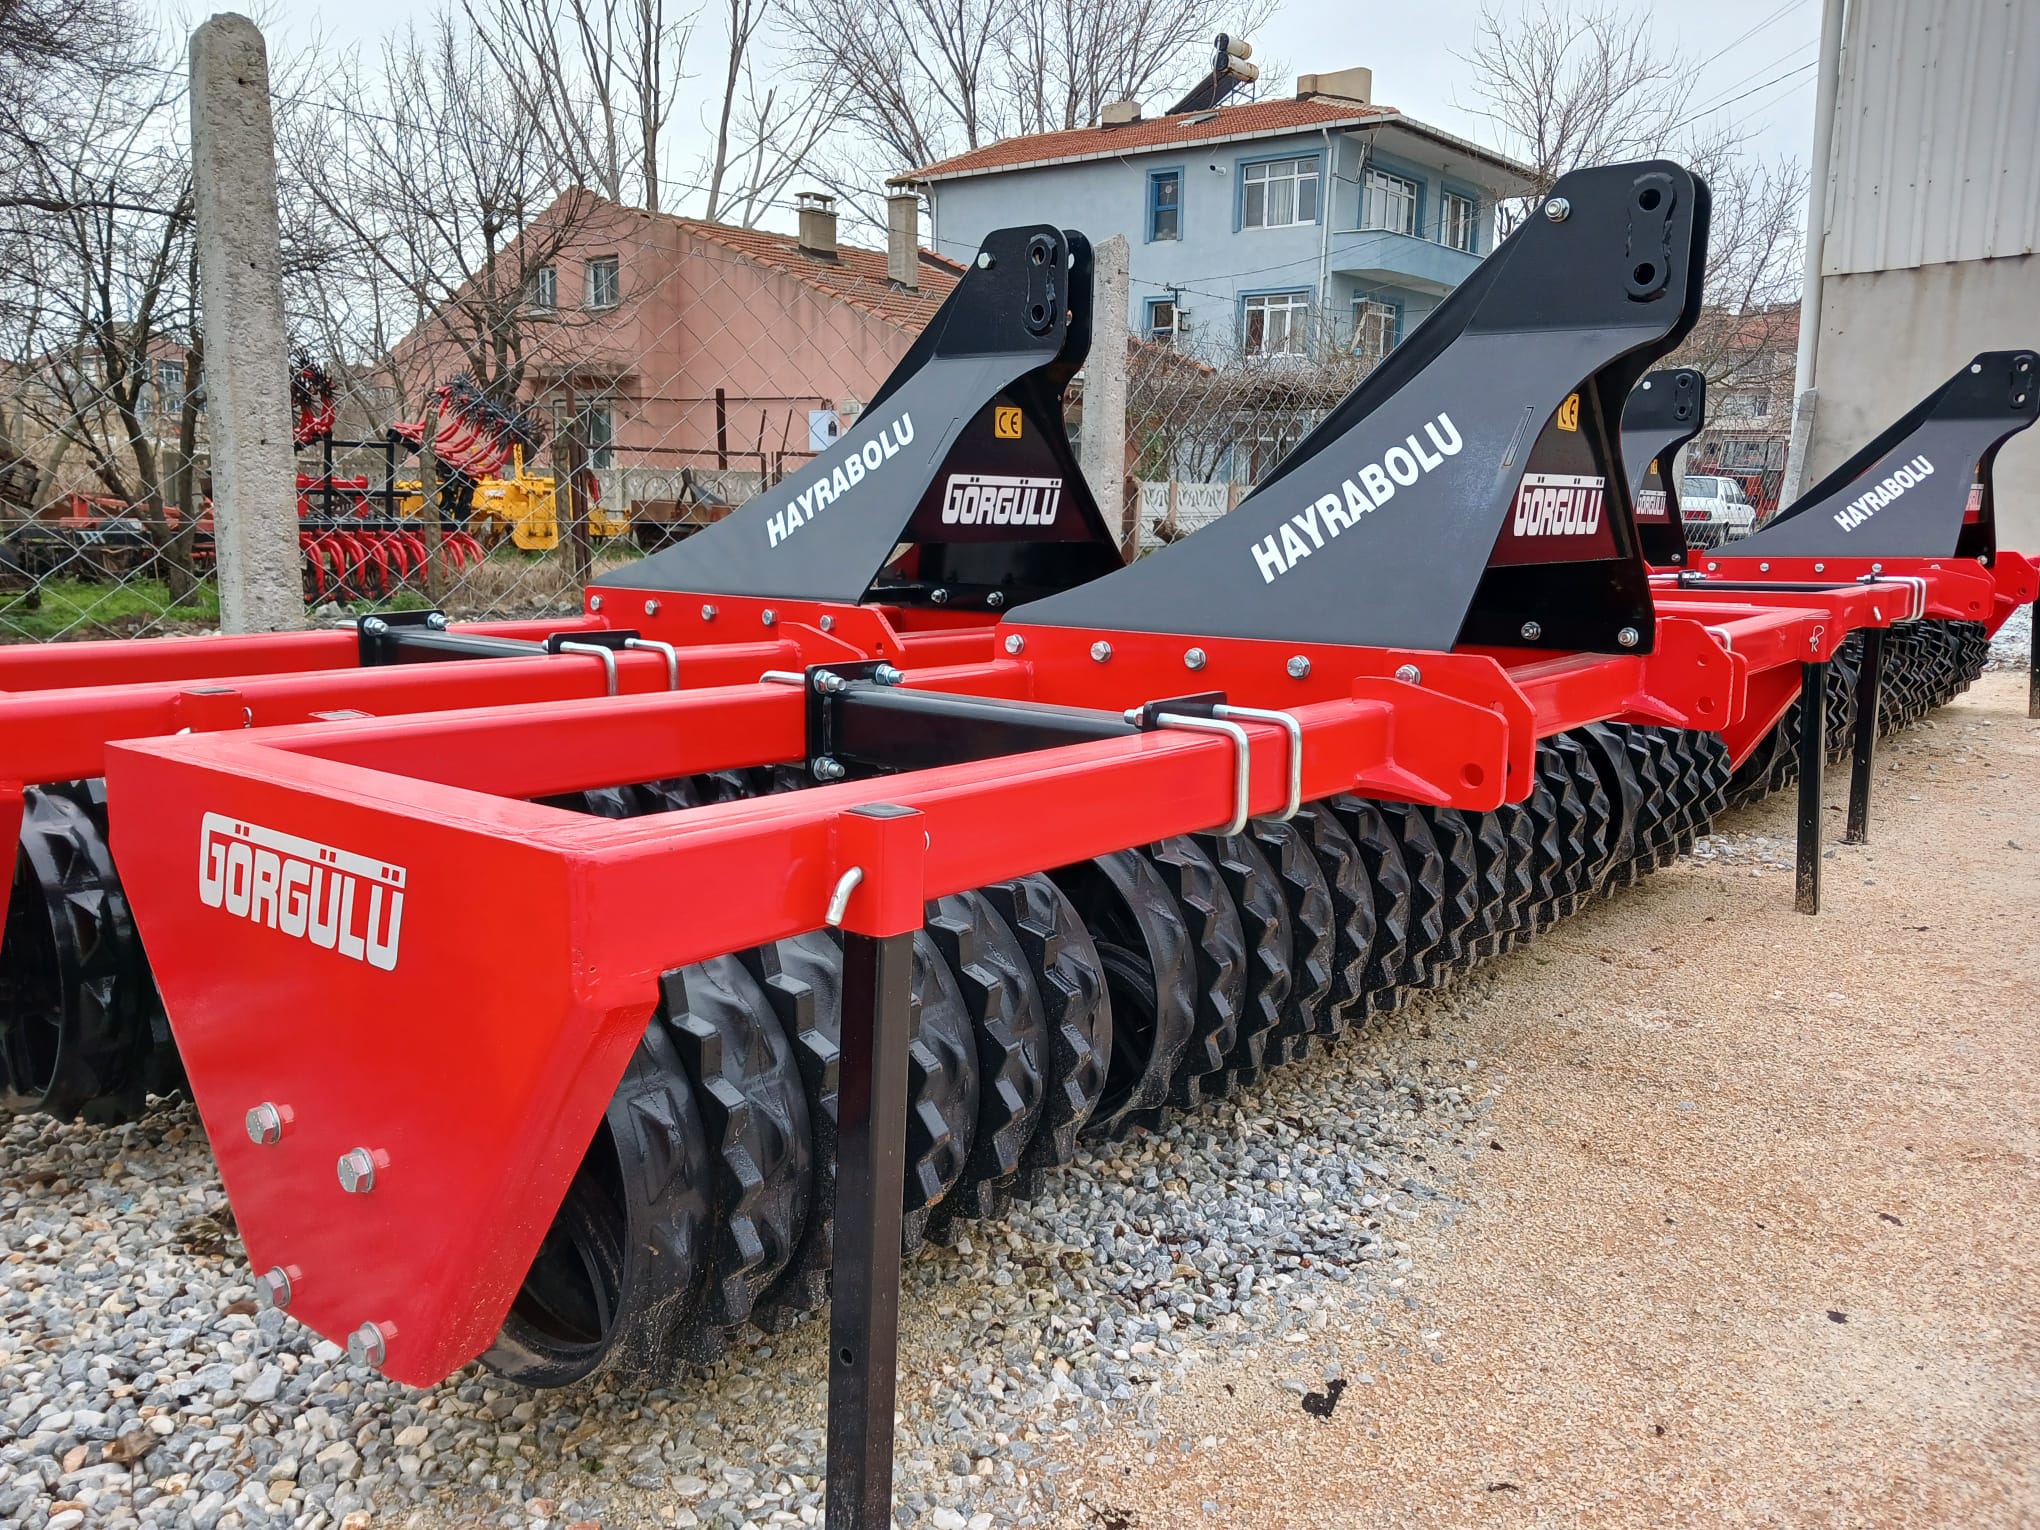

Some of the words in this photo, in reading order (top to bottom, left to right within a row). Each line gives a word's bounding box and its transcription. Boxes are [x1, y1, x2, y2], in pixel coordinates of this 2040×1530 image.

[766, 412, 914, 548] HAYRABOLU
[942, 473, 1062, 525] GÖRGÜLÜ
[1250, 411, 1464, 584] HAYRABOLU
[1513, 473, 1606, 536] GÖRGÜLÜ
[1833, 454, 1935, 532] HAYRABOLU
[199, 811, 407, 971] GÖRGÜLÜ
